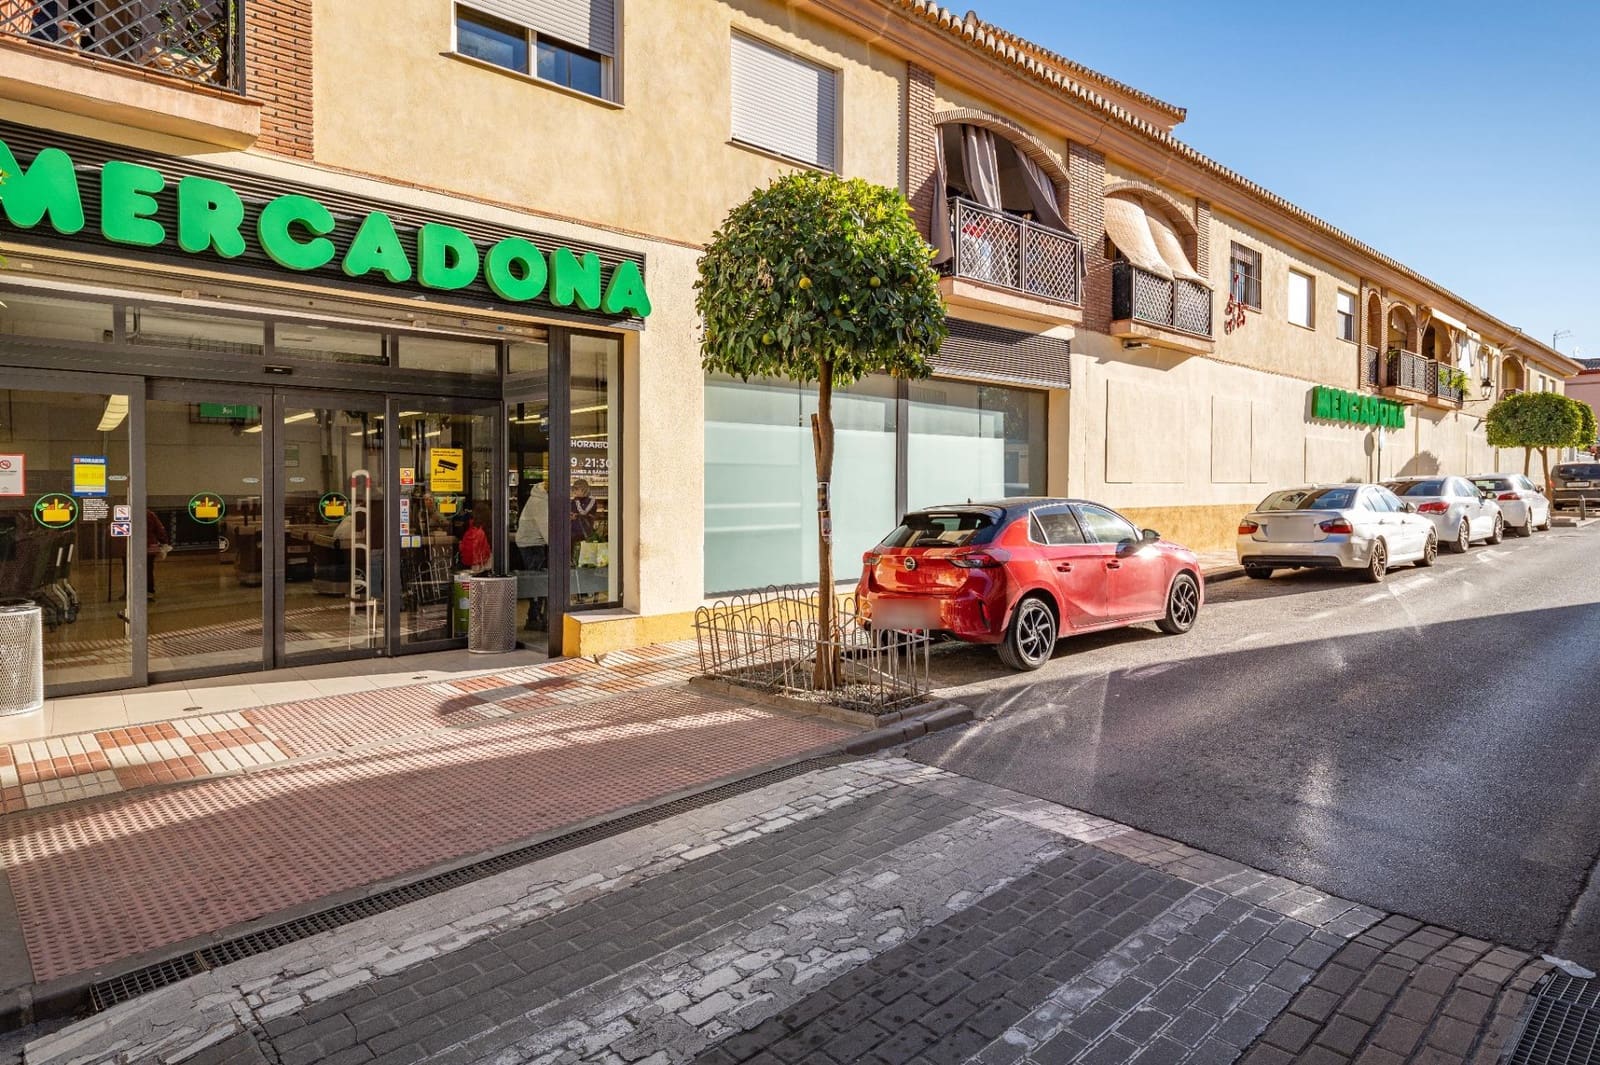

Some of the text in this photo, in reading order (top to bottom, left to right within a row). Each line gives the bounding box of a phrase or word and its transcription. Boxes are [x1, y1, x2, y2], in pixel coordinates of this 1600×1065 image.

[0, 138, 652, 318] MERCADONA
[1312, 385, 1405, 429] MERCADONA
[570, 440, 609, 449] HORARIO
[570, 457, 578, 467] 9
[585, 457, 613, 468] 21:30
